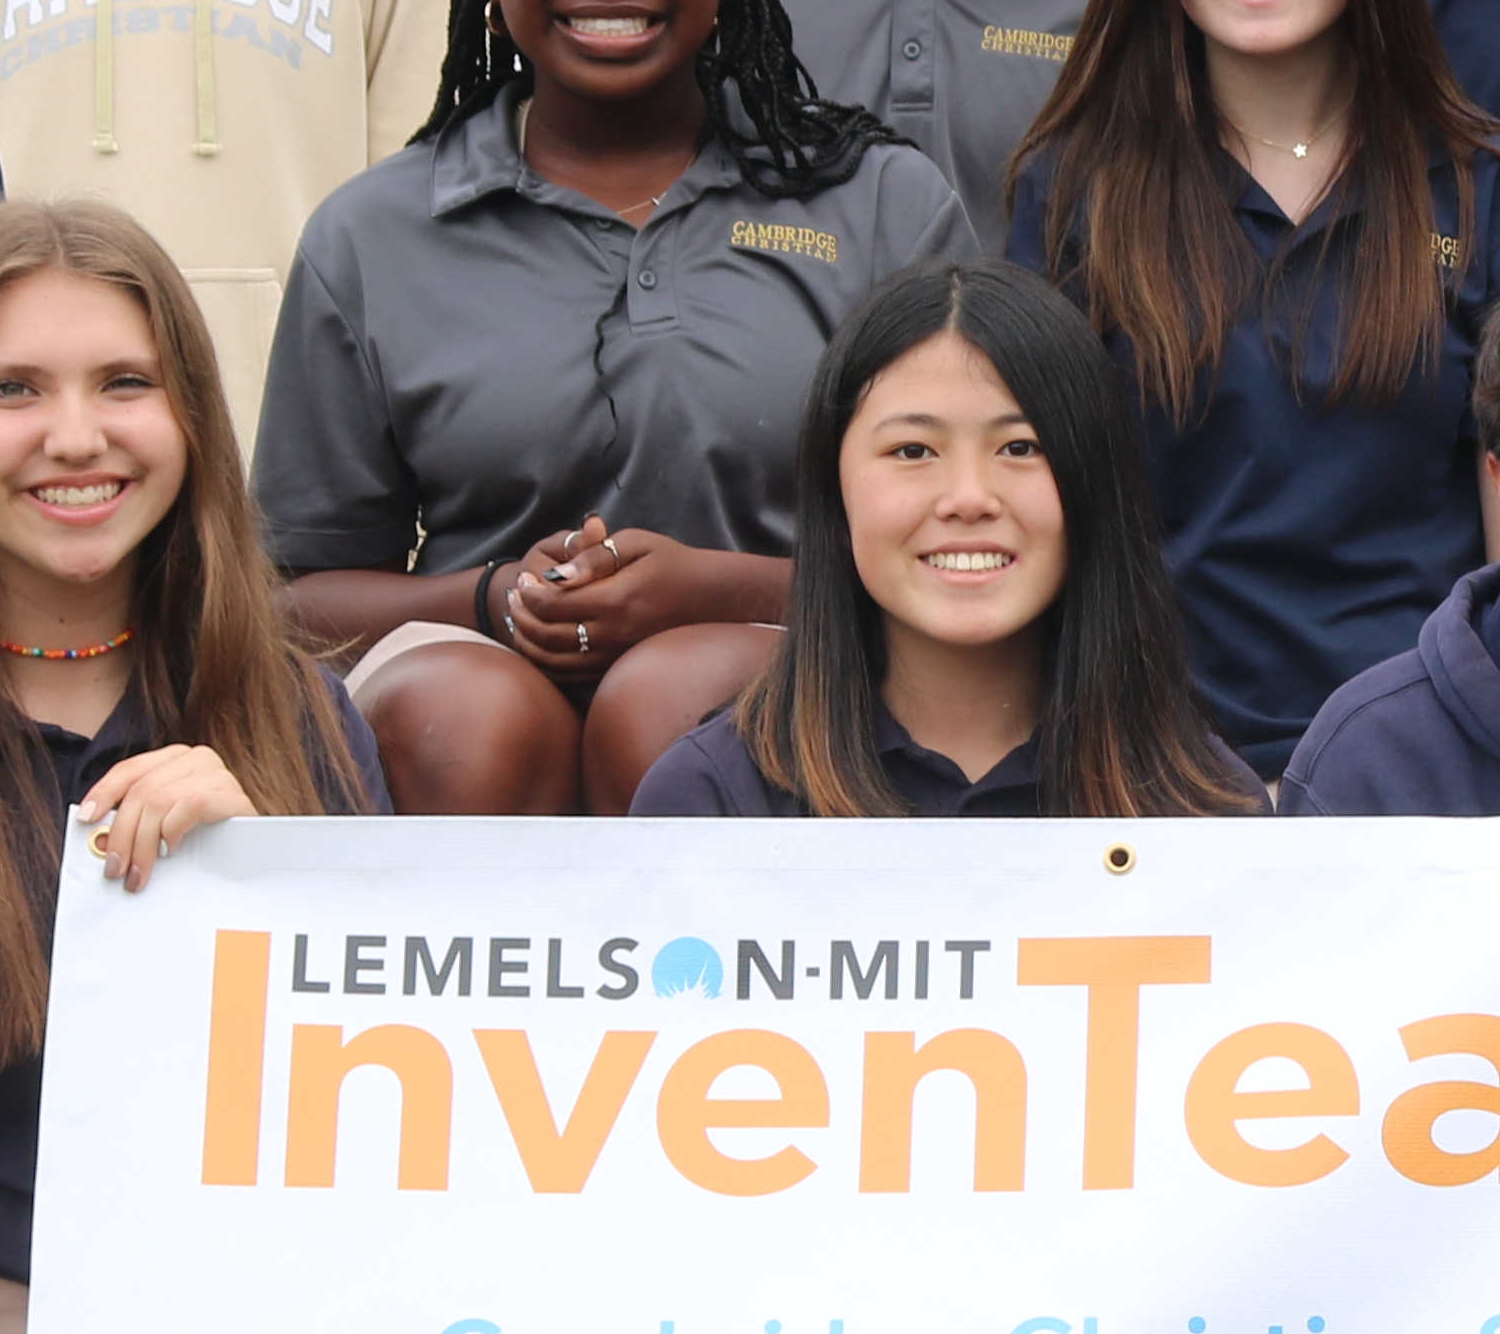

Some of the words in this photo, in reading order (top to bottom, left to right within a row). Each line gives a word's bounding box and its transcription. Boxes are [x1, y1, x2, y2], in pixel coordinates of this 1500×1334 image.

[984, 25, 1076, 52] CAMBRIDGE
[730, 235, 838, 263] CHRISTIAN
[732, 220, 838, 253] CAMBRIDGE
